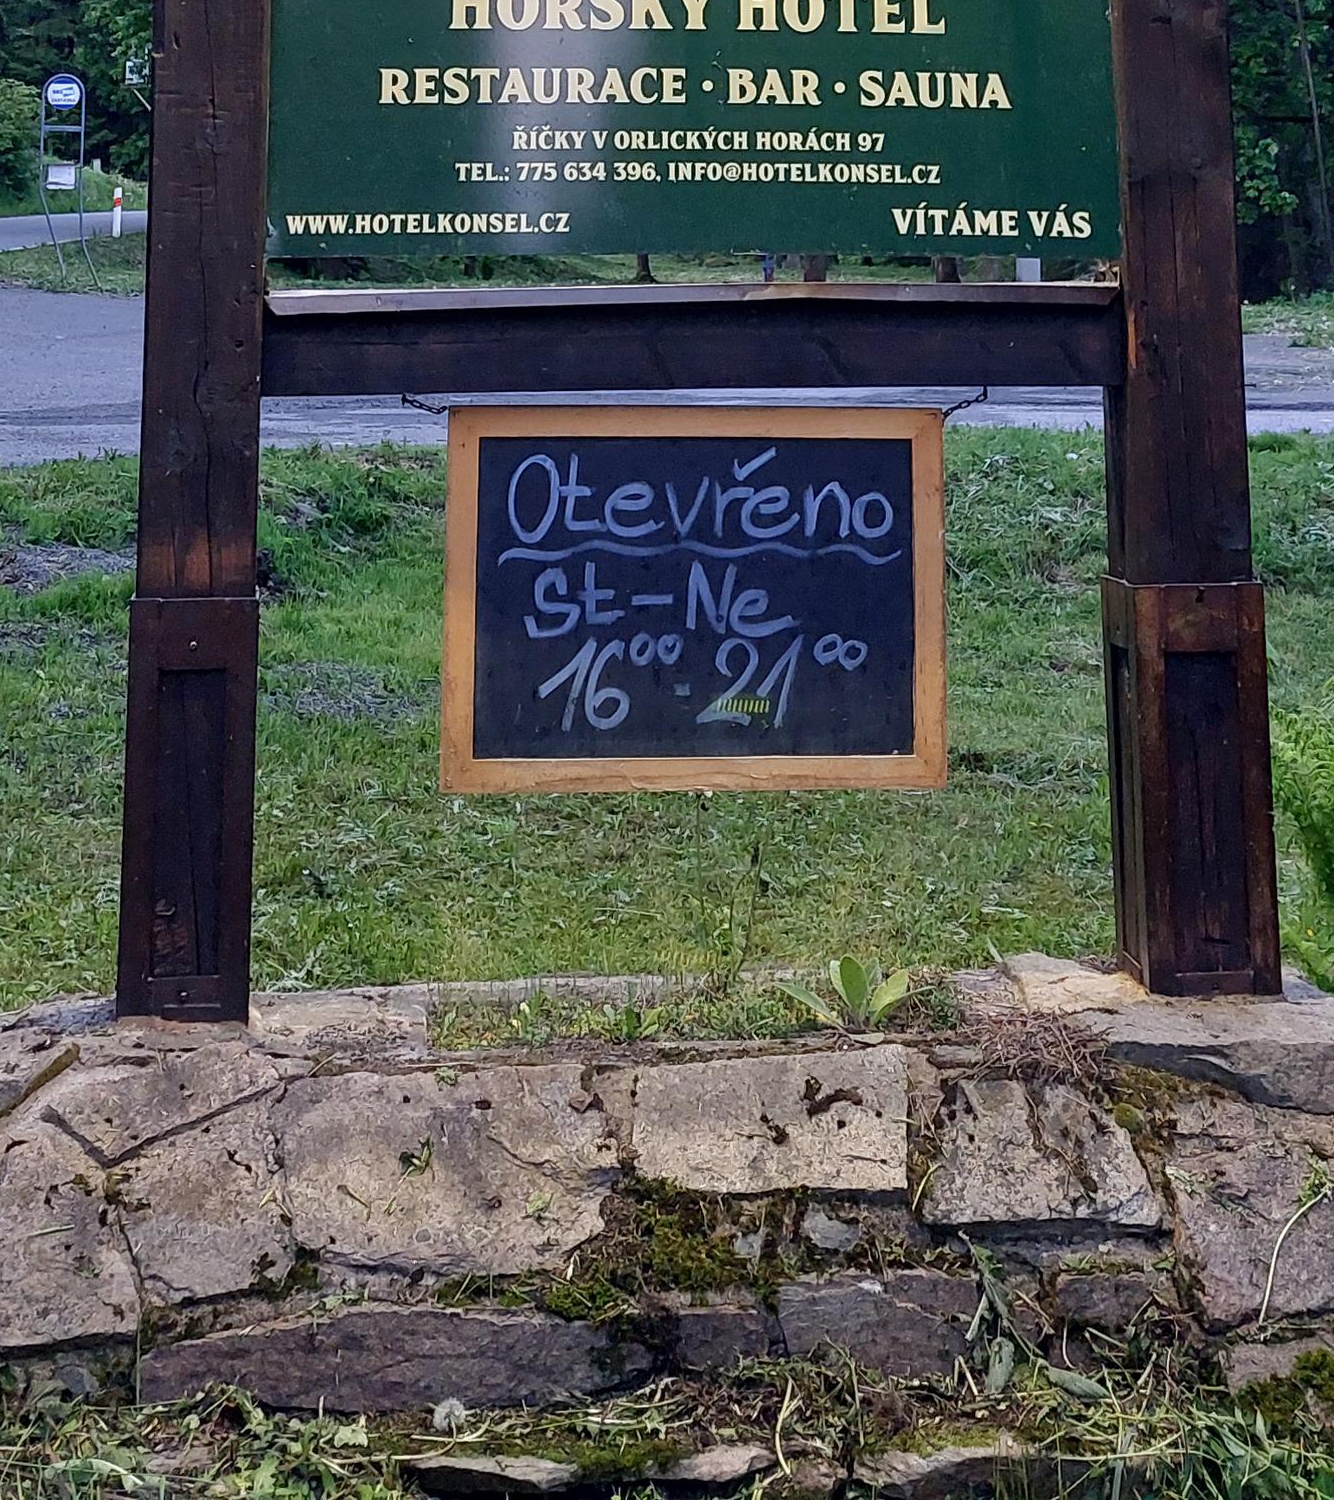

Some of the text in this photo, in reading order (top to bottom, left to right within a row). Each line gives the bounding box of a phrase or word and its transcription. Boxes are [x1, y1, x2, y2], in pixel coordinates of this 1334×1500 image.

[378, 67, 1013, 110] RESTAURACE BAR SAUNA
[512, 125, 885, 152] ŘÍČKY V ORLICKÝCH HORÁCH 97
[455, 162, 942, 185] TEL.: 775 634 396, INFO@HOTELKONSEL.CZ
[285, 212, 571, 236] WWW.HOTELKONSEL.CZ
[891, 203, 1093, 239] VÍTÁME VÁS
[506, 446, 895, 545] Otevřeno
